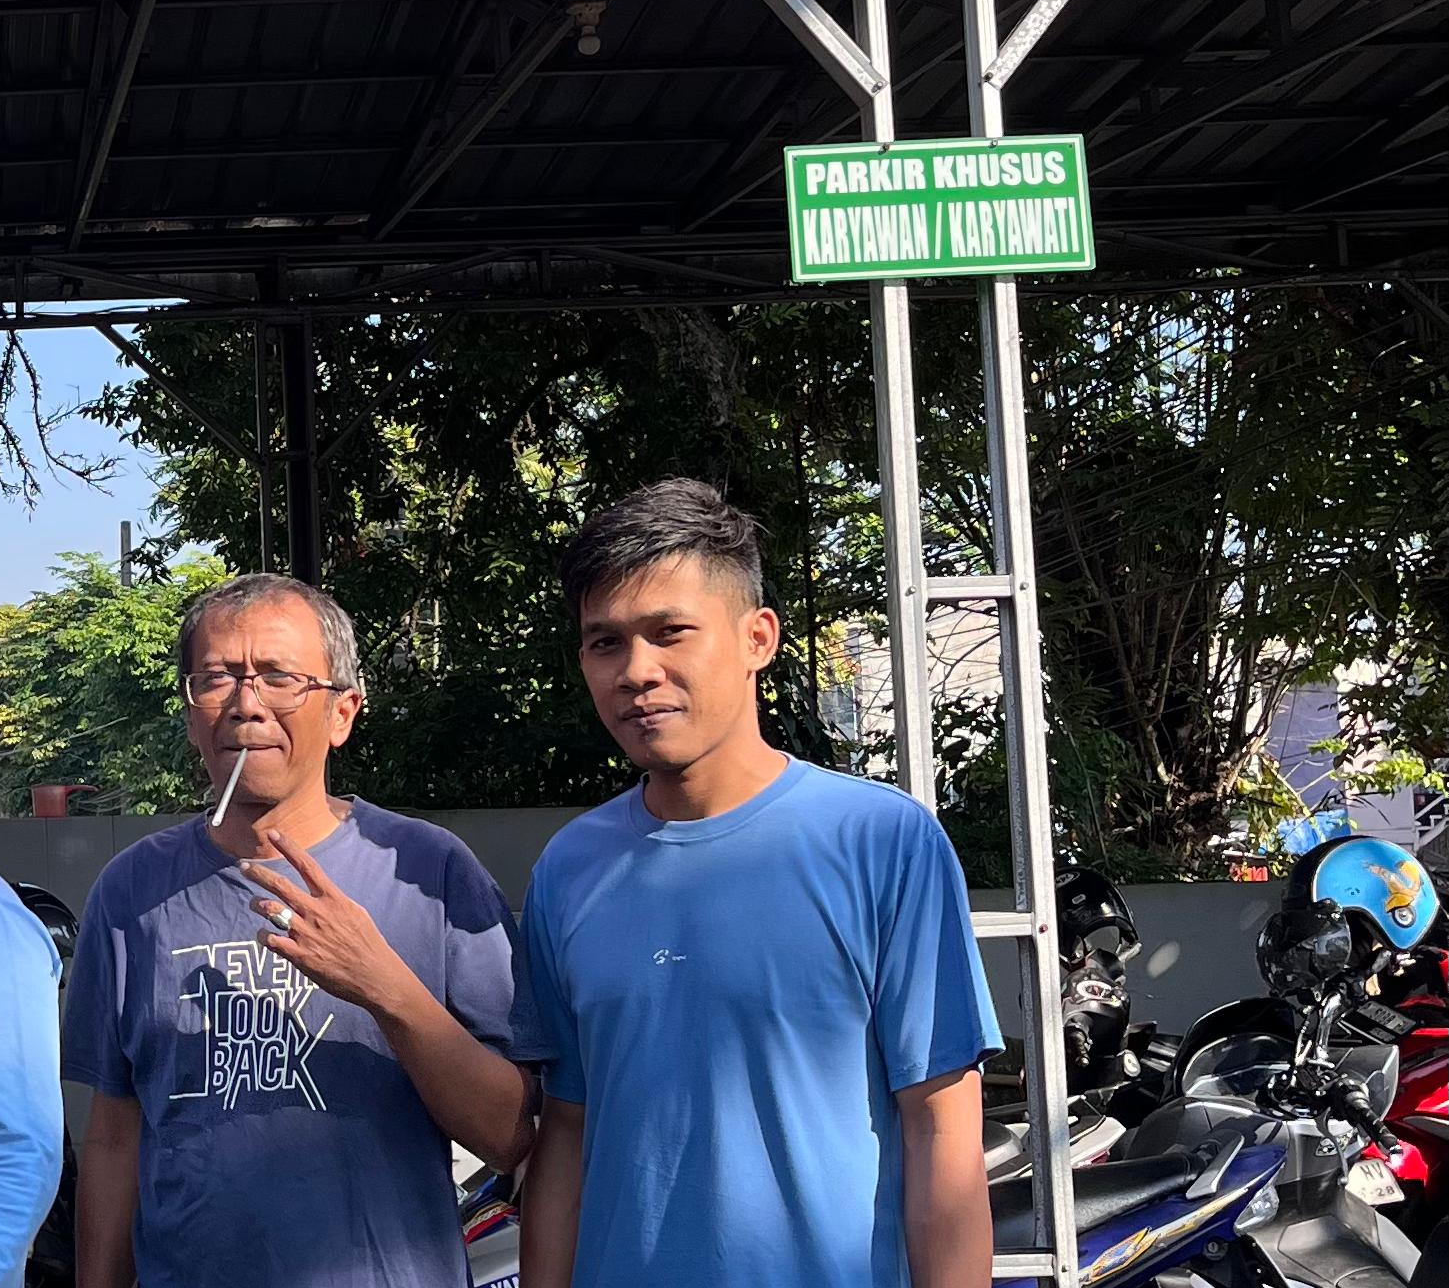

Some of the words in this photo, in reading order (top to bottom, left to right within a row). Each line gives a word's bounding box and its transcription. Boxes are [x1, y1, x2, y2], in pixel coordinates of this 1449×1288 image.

[806, 158, 926, 195] PARKIR
[933, 151, 1066, 188] KHUSUS
[802, 203, 930, 265] KARYAWAN
[948, 197, 1080, 258] KARYAWATI
